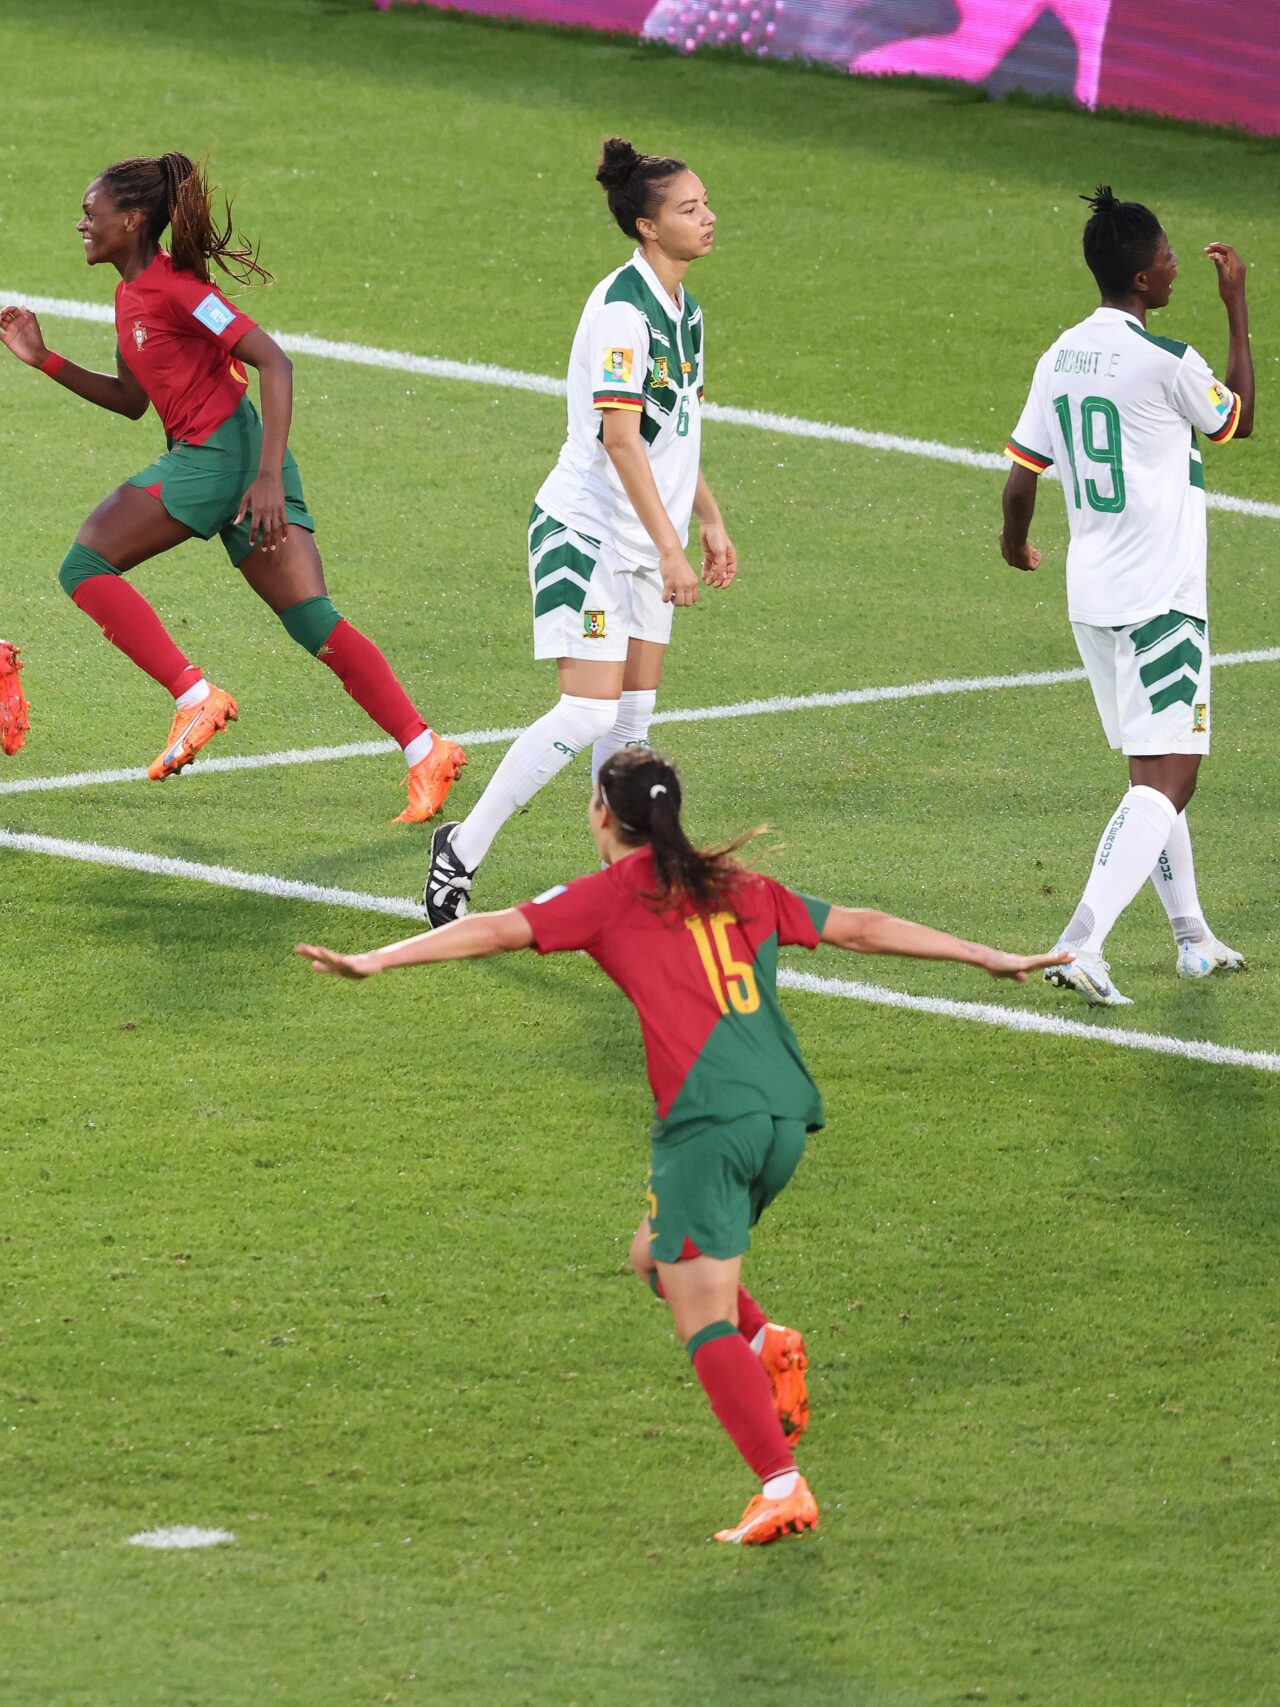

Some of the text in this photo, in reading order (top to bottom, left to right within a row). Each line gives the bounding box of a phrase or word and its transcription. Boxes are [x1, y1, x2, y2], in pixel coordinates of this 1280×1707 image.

[677, 395, 690, 437] 6
[1053, 394, 1126, 514] 19
[1098, 806, 1131, 867] CAMEROUN
[684, 911, 761, 1015] 15
